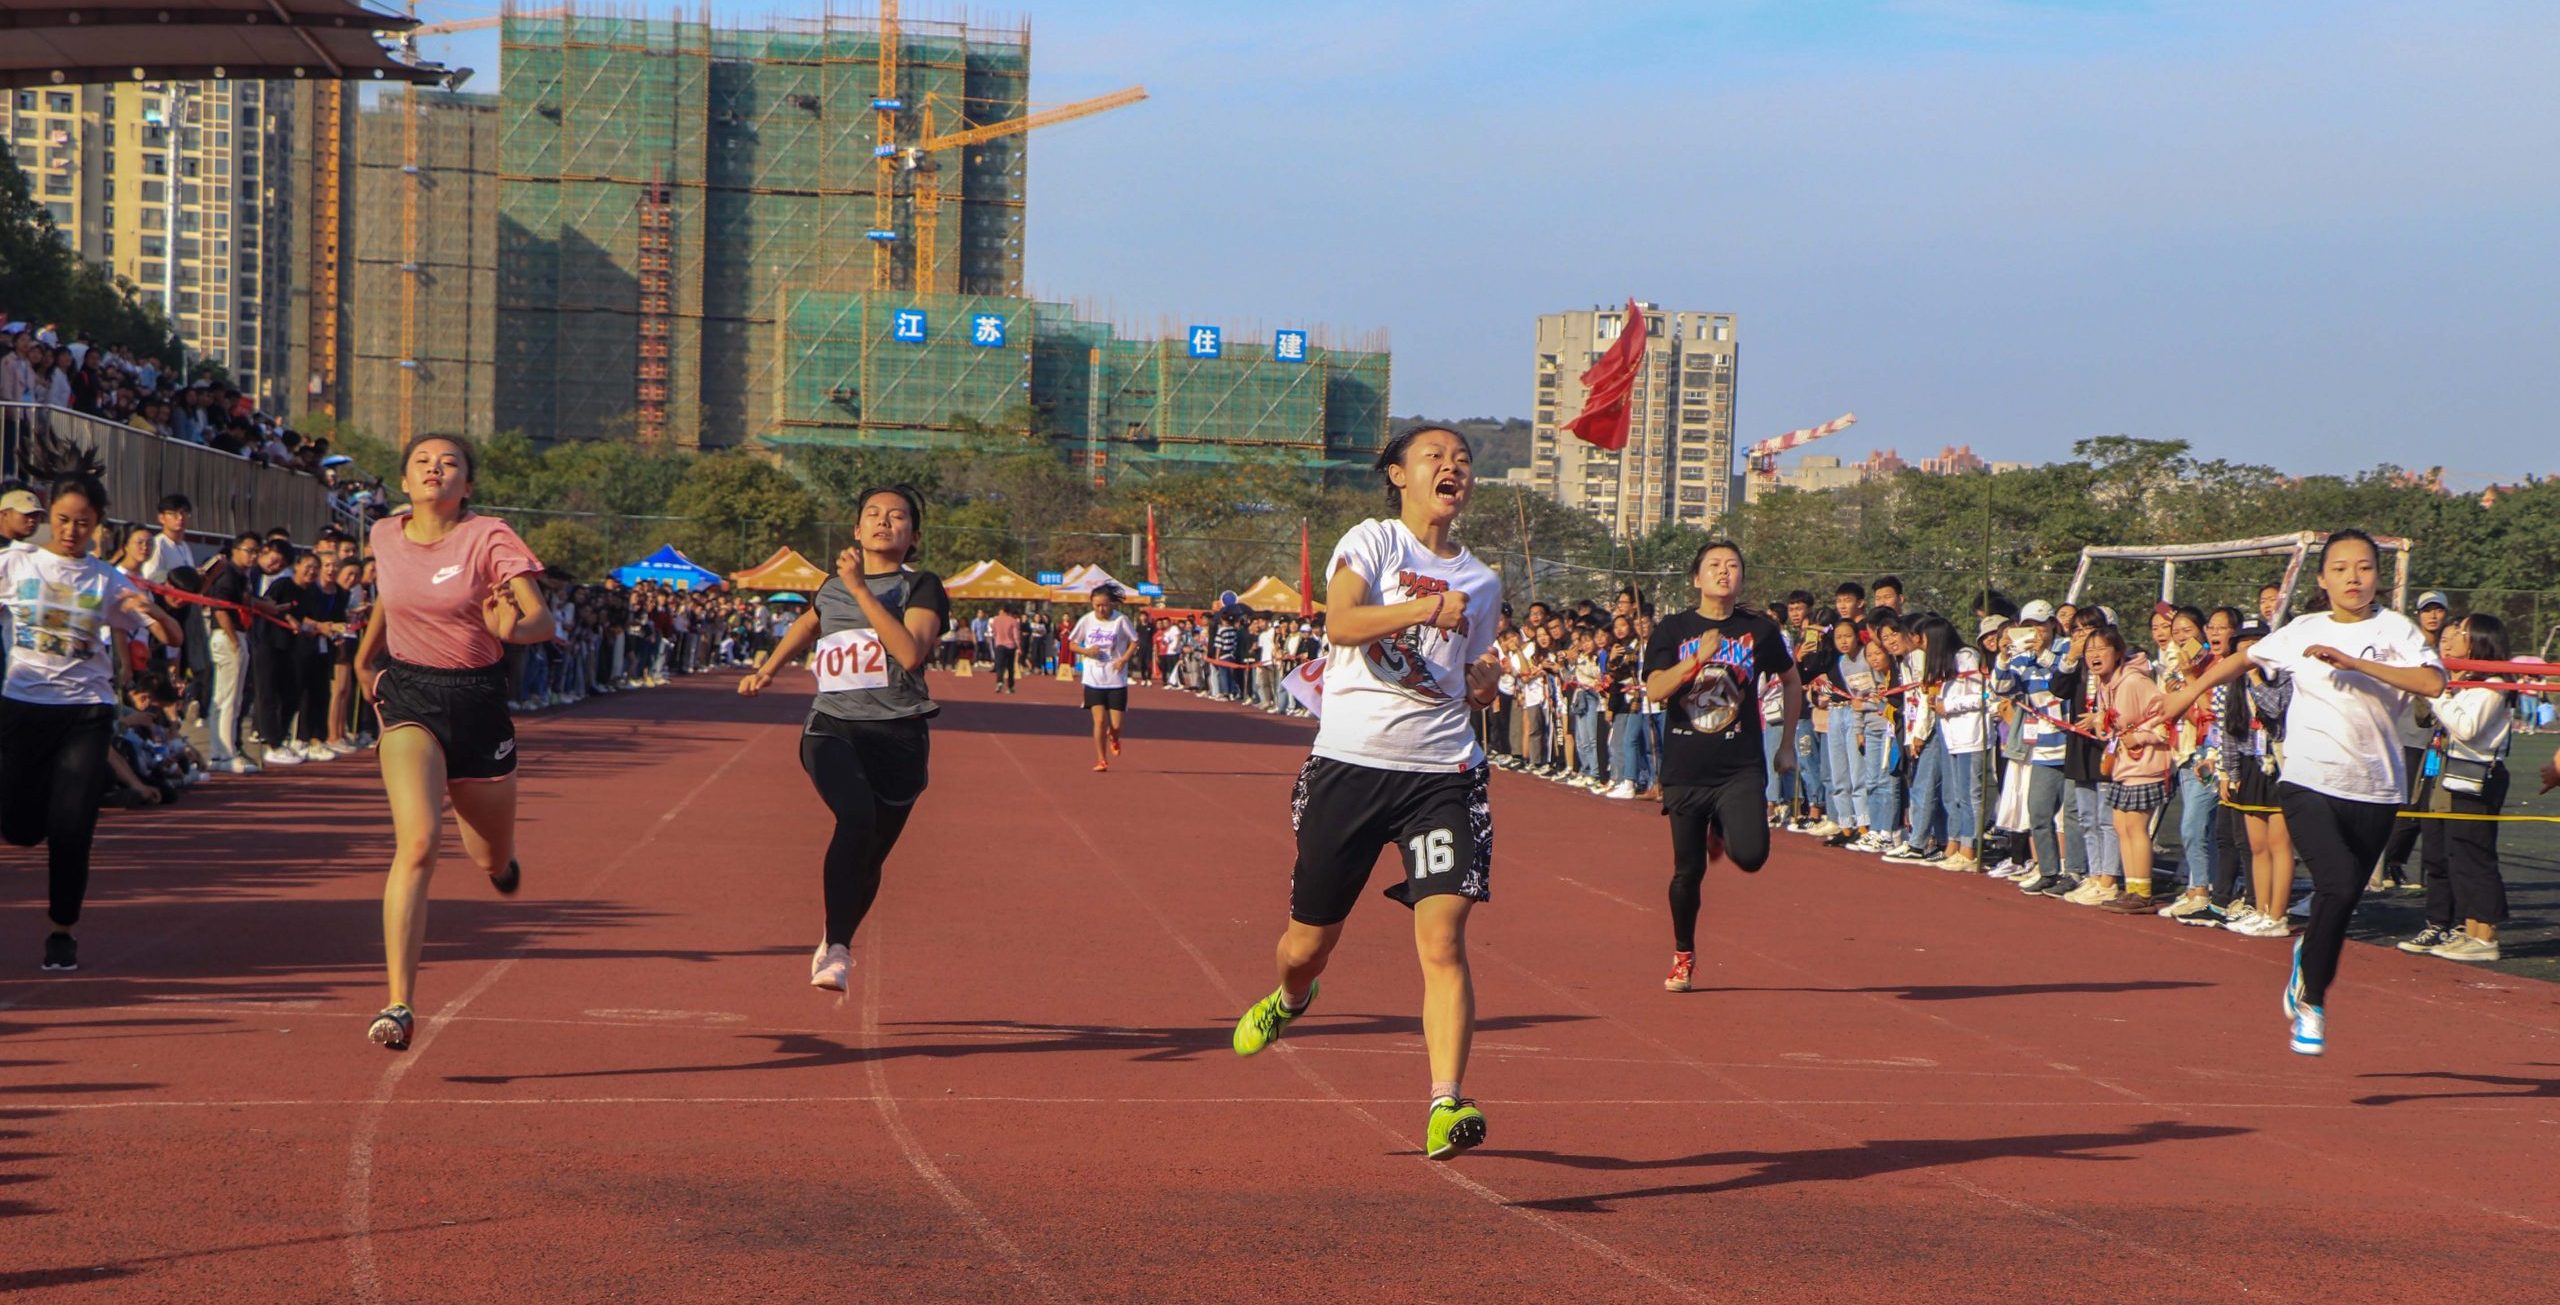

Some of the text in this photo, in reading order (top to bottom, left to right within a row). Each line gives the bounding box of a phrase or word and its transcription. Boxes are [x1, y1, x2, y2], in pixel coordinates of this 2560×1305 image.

[1399, 571, 1449, 596] MADE
[816, 641, 884, 677] 1012
[1409, 829, 1454, 879] 16
